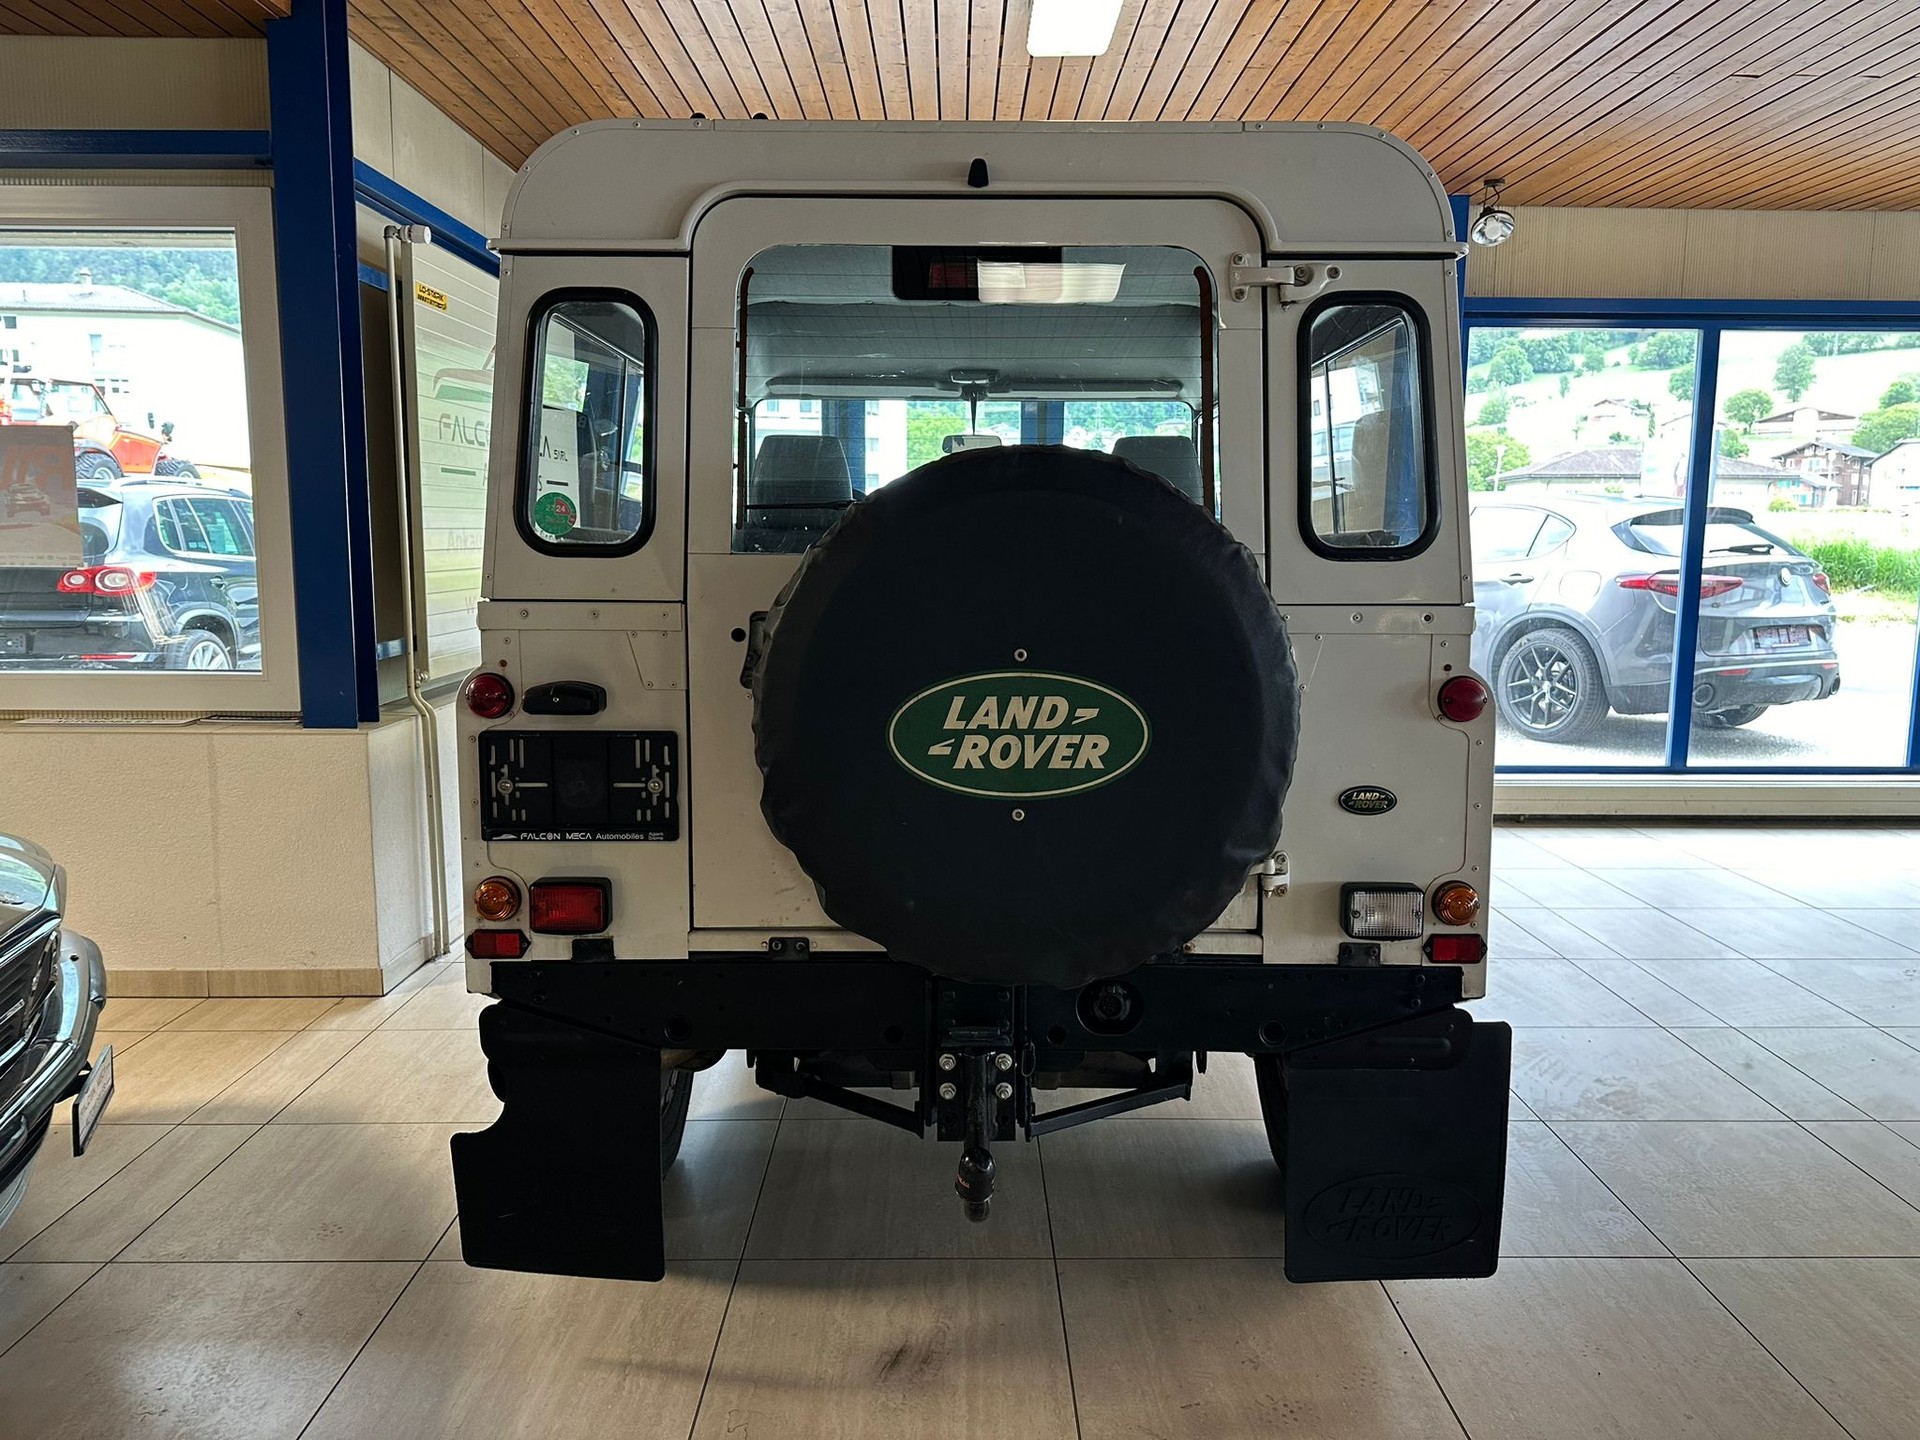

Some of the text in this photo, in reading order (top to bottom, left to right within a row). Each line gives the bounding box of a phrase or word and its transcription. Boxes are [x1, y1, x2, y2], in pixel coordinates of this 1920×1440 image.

[439, 413, 489, 447] FALC
[556, 504, 566, 513] 24
[447, 529, 482, 553] Ankau
[943, 696, 1069, 729] LAND
[952, 735, 1110, 769] ROVER
[1352, 792, 1380, 800] LAND
[520, 832, 644, 840] FALCON MECA Automobiles
[1337, 1187, 1424, 1213] LAND
[1345, 1216, 1450, 1242] ROVER
